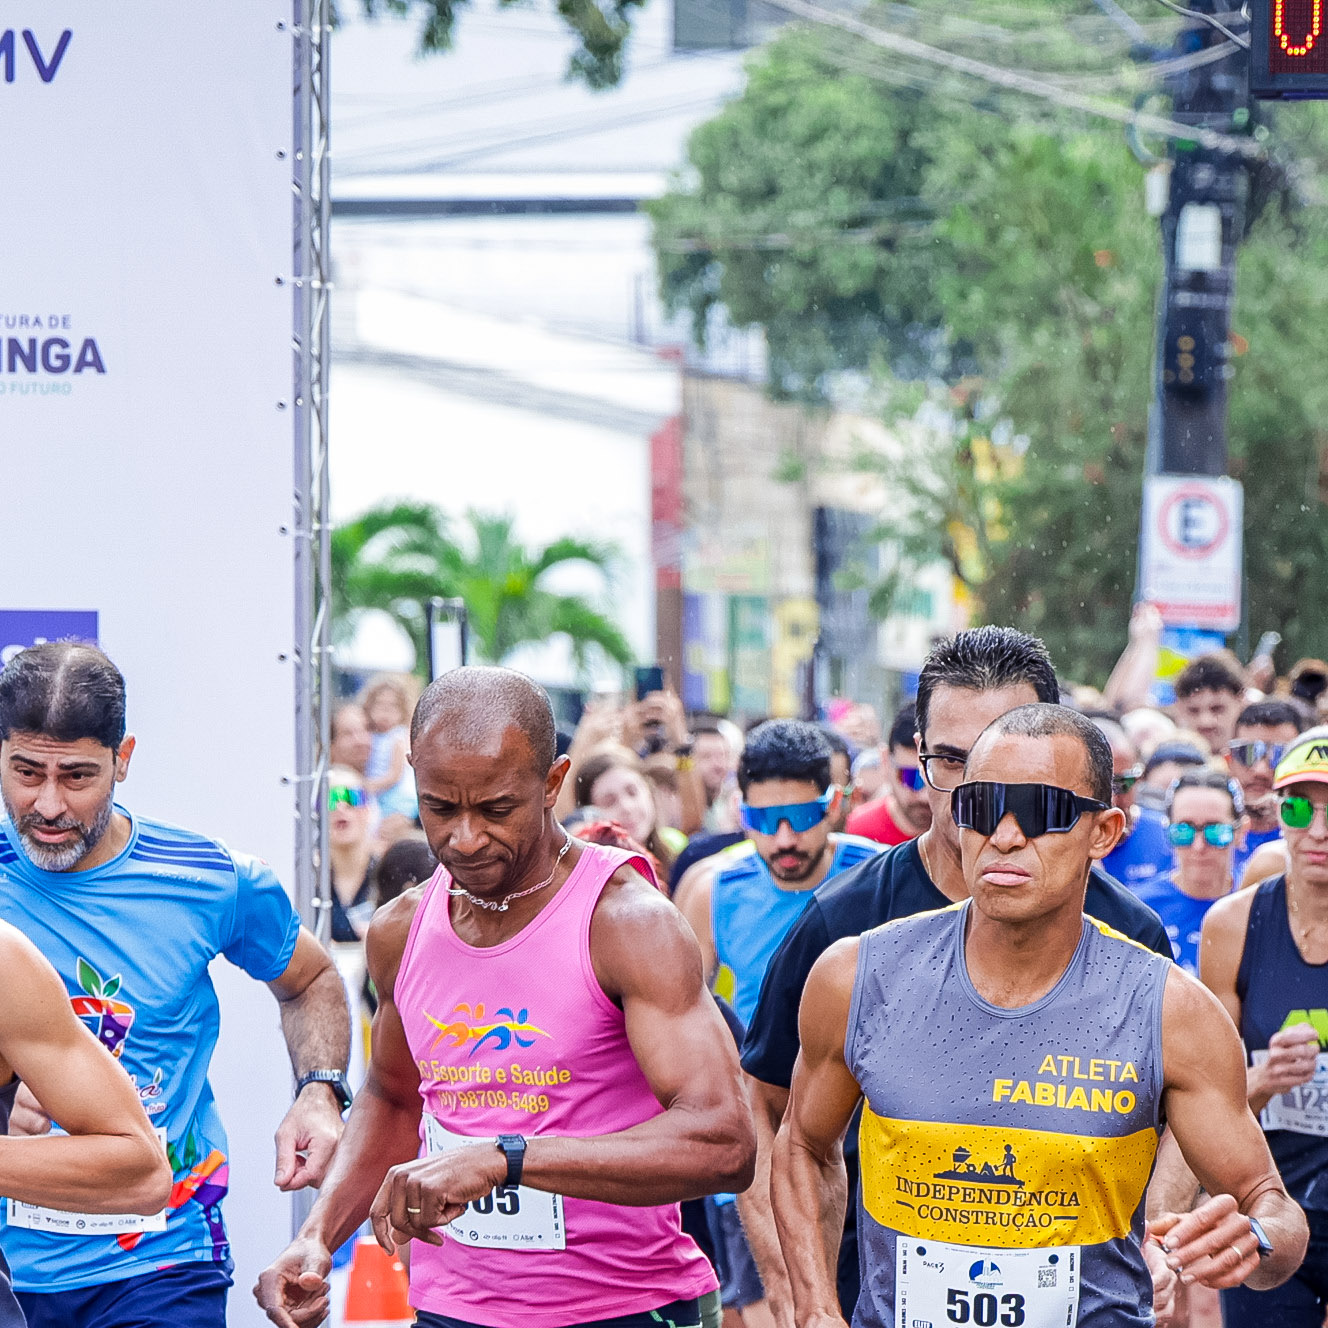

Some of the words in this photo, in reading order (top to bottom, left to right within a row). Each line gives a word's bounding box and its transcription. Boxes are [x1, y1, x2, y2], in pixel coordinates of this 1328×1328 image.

[48, 314, 72, 329] DE
[10, 382, 72, 395] FUTURO
[1179, 499, 1213, 548] E
[431, 1061, 490, 1086] Esporte
[496, 1069, 507, 1083] e
[510, 1065, 571, 1086] Saúde
[1038, 1055, 1138, 1083] ATLETA
[993, 1079, 1137, 1114] FABIANO
[465, 1184, 520, 1215] 05
[896, 1176, 1080, 1207] INDEPENDÊNCIA
[918, 1204, 1053, 1231] CONSTRUÇÃO
[947, 1288, 1025, 1327] 503
